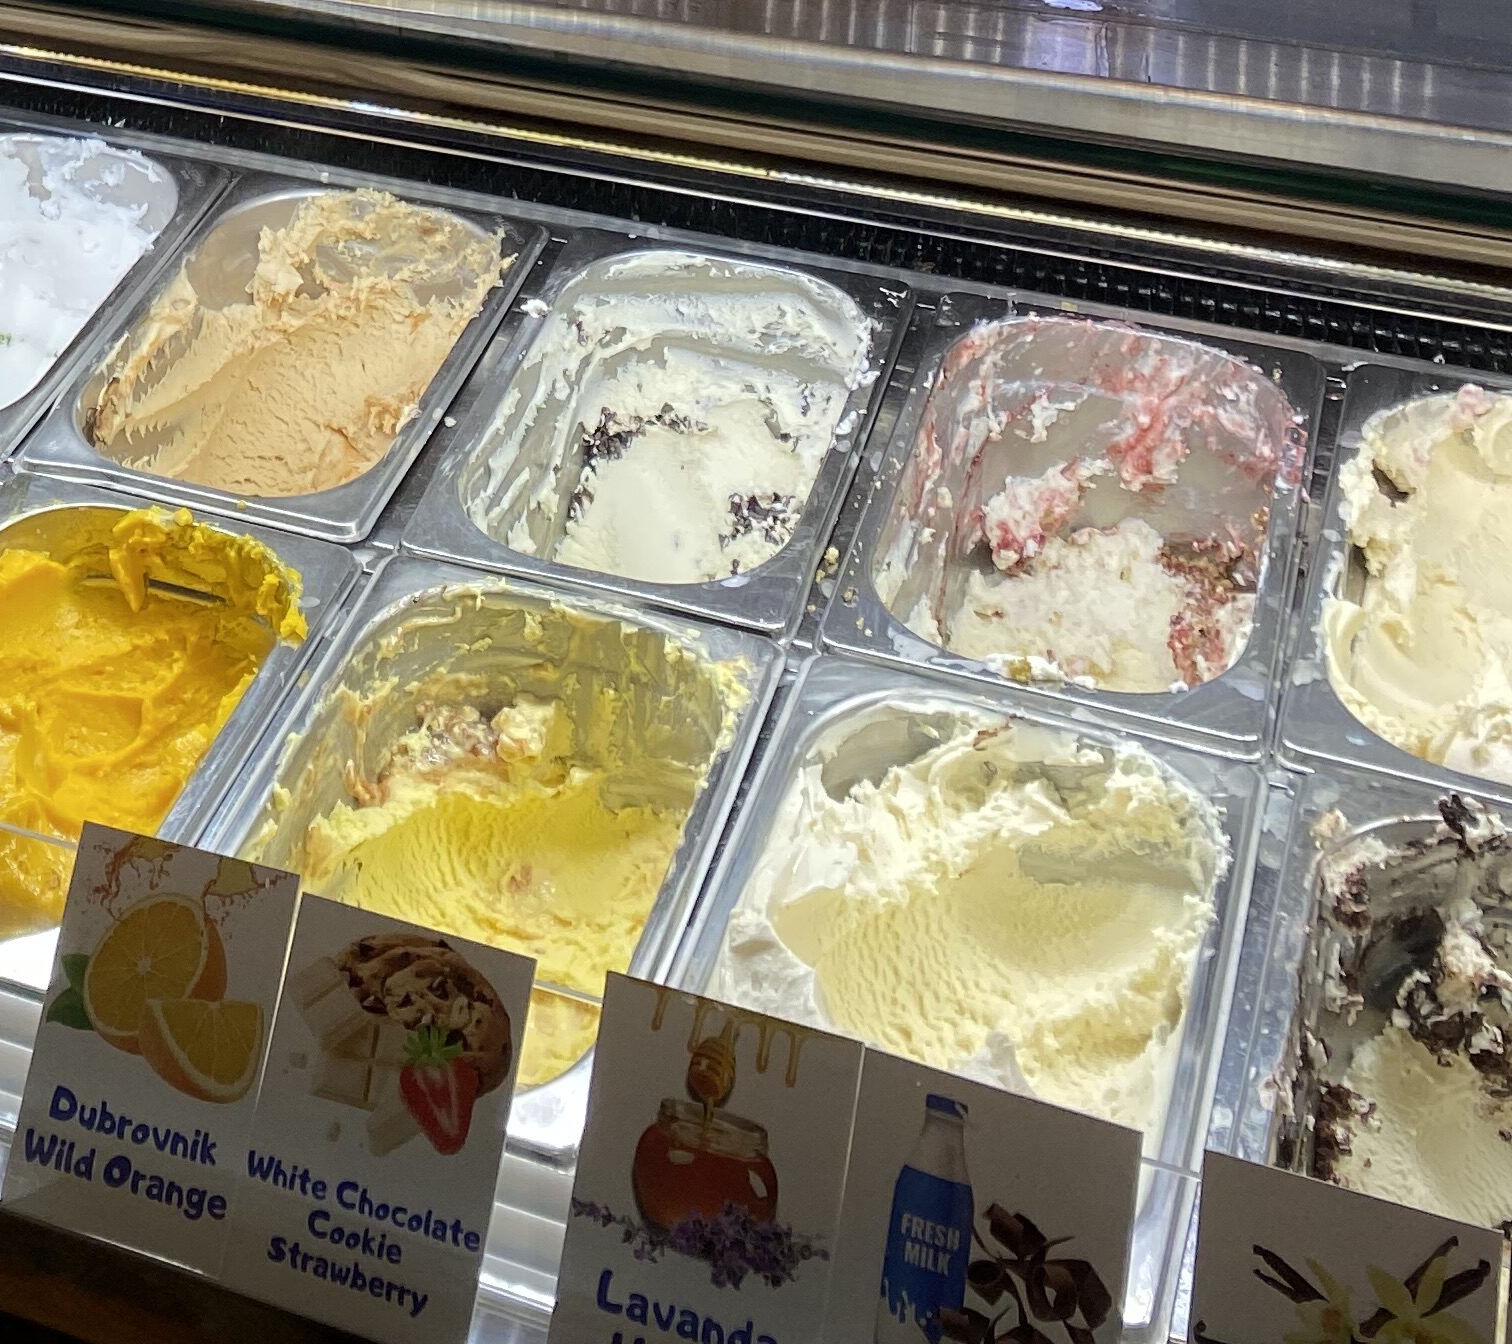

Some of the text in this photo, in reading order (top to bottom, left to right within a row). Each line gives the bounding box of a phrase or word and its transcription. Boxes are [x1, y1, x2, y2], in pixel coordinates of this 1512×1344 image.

[49, 1085, 216, 1166] Dubrovnik
[24, 1129, 228, 1221] Wild Orange
[248, 1150, 482, 1253] White Chocolate
[308, 1210, 402, 1265] Cookie
[900, 1214, 961, 1252] FRESH
[904, 1241, 951, 1276] MILK
[268, 1236, 428, 1317] Strawberry
[597, 1269, 777, 1344] Lavand
